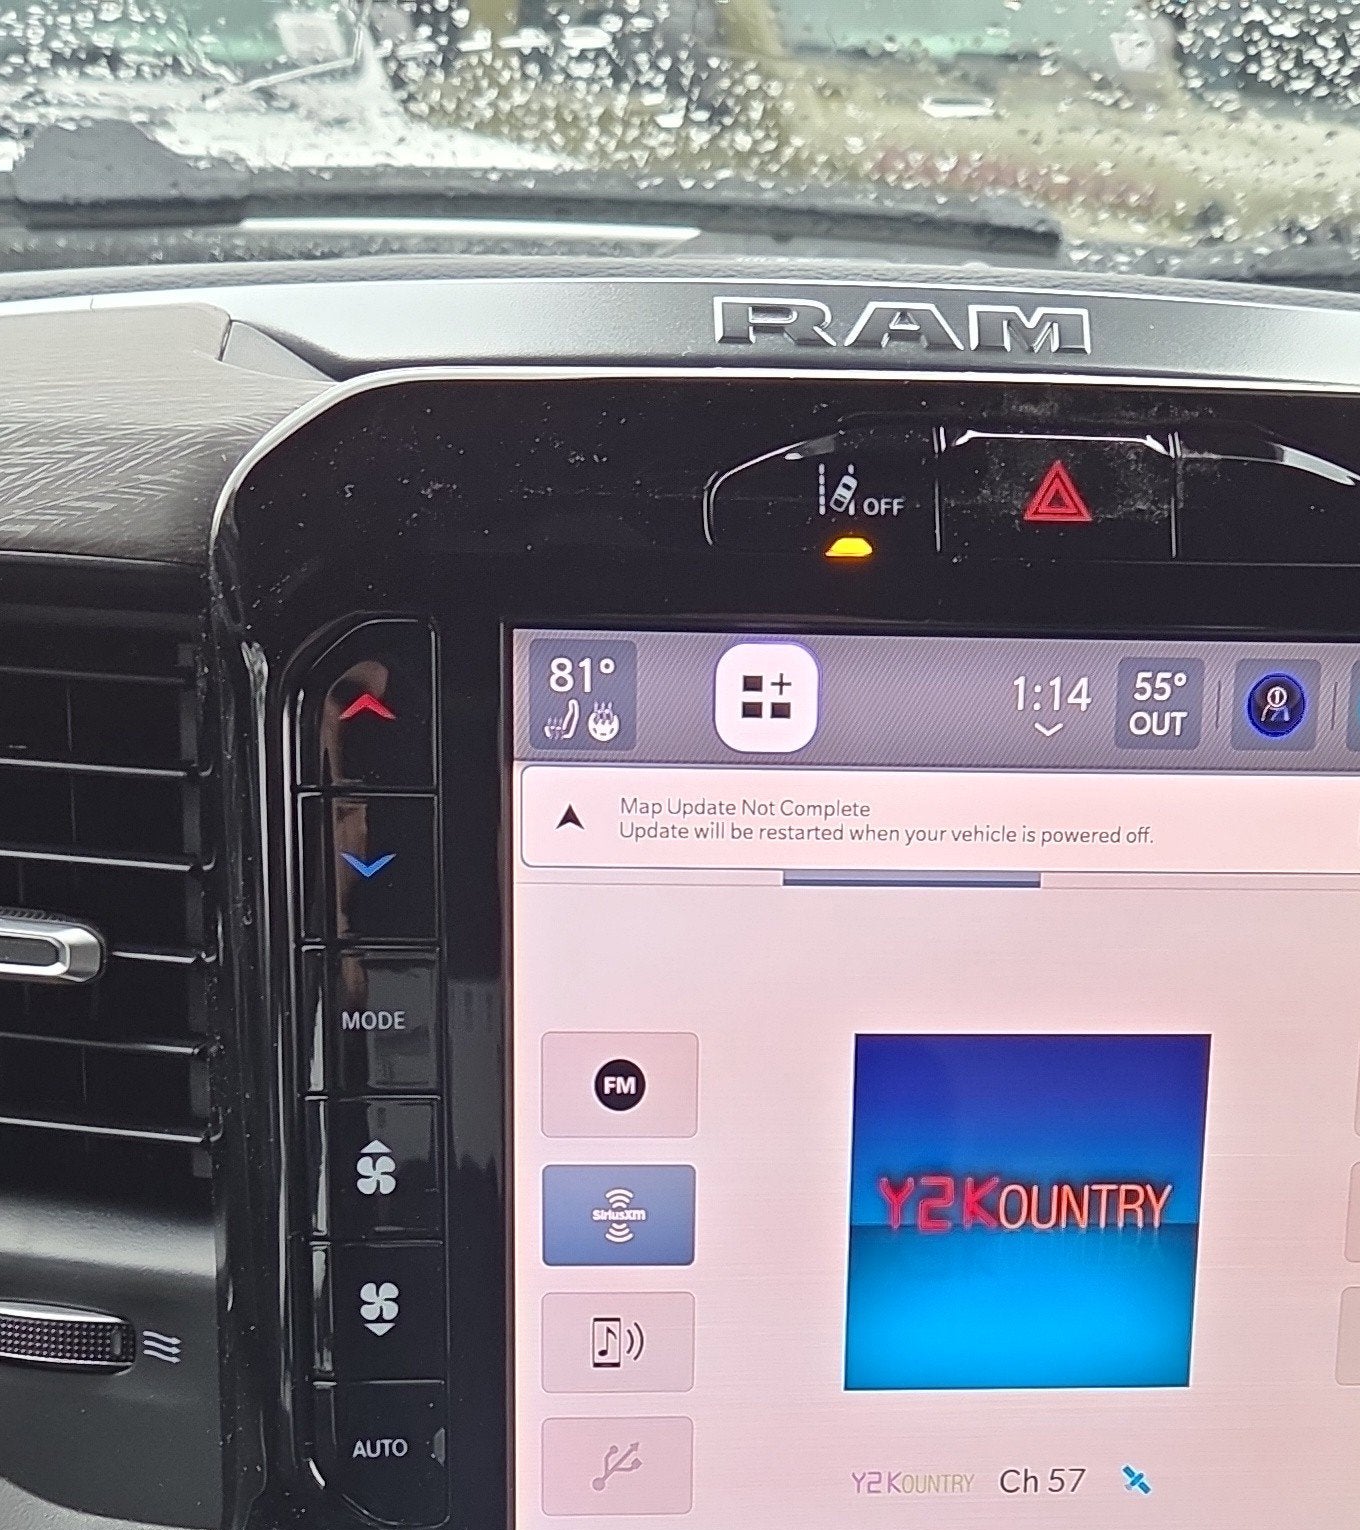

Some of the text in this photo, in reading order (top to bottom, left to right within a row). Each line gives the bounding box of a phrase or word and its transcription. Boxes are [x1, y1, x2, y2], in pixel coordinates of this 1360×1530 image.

[714, 295, 1092, 355] RAM
[862, 497, 905, 518] OFF
[548, 656, 616, 693] 81°
[1132, 671, 1188, 702] 55°
[1012, 675, 1093, 713] 1:14
[1129, 710, 1188, 737] OUT
[620, 797, 871, 820] Map Update Not Complete
[619, 821, 1155, 848] Update will be restarted when your vehicle is powered off.
[340, 1010, 407, 1031] MODE
[603, 1075, 637, 1095] FM
[351, 1439, 409, 1459] AUTO
[999, 1467, 1039, 1494] Ch
[1047, 1468, 1086, 1494] 57
